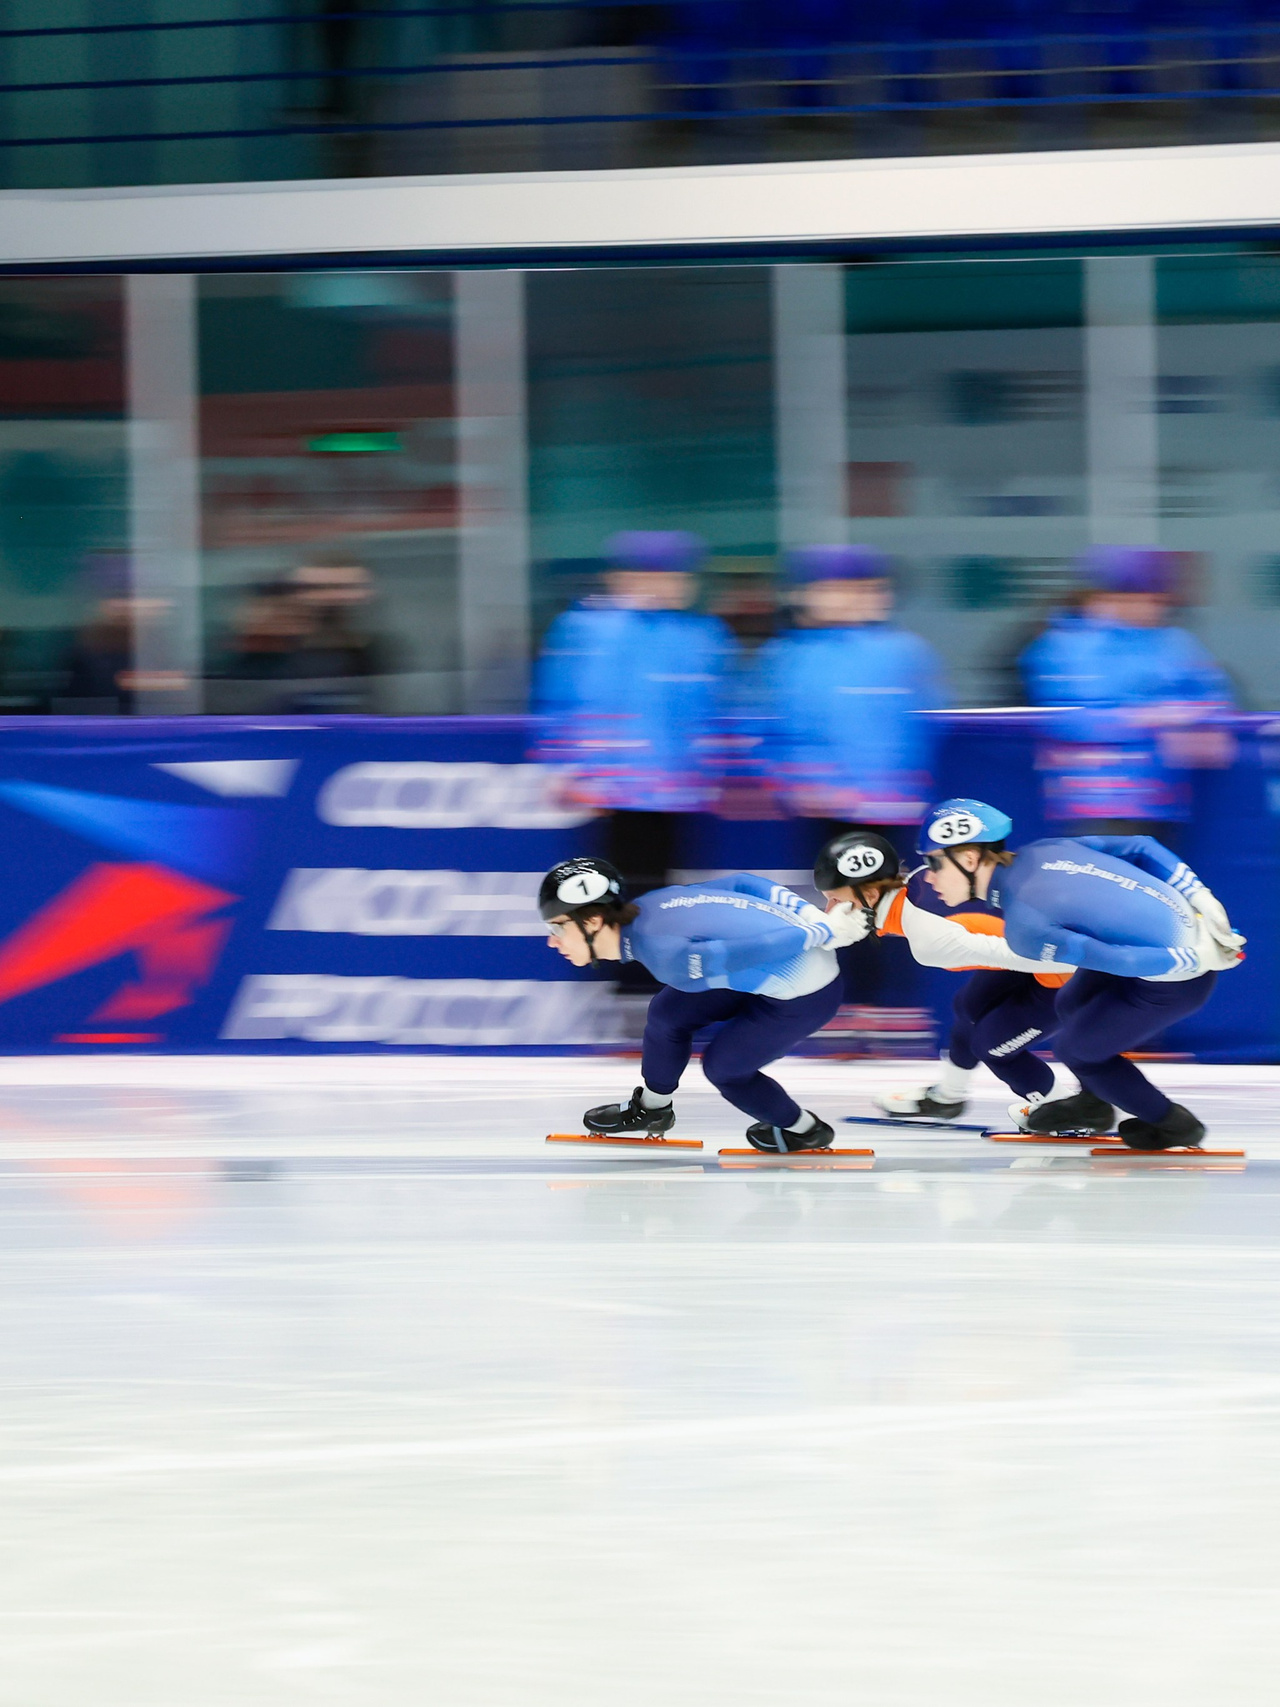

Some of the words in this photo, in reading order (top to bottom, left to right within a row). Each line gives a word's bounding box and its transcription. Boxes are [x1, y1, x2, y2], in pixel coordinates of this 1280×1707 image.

[940, 819, 971, 839] 35
[847, 851, 877, 872] 36
[577, 879, 590, 896] 1
